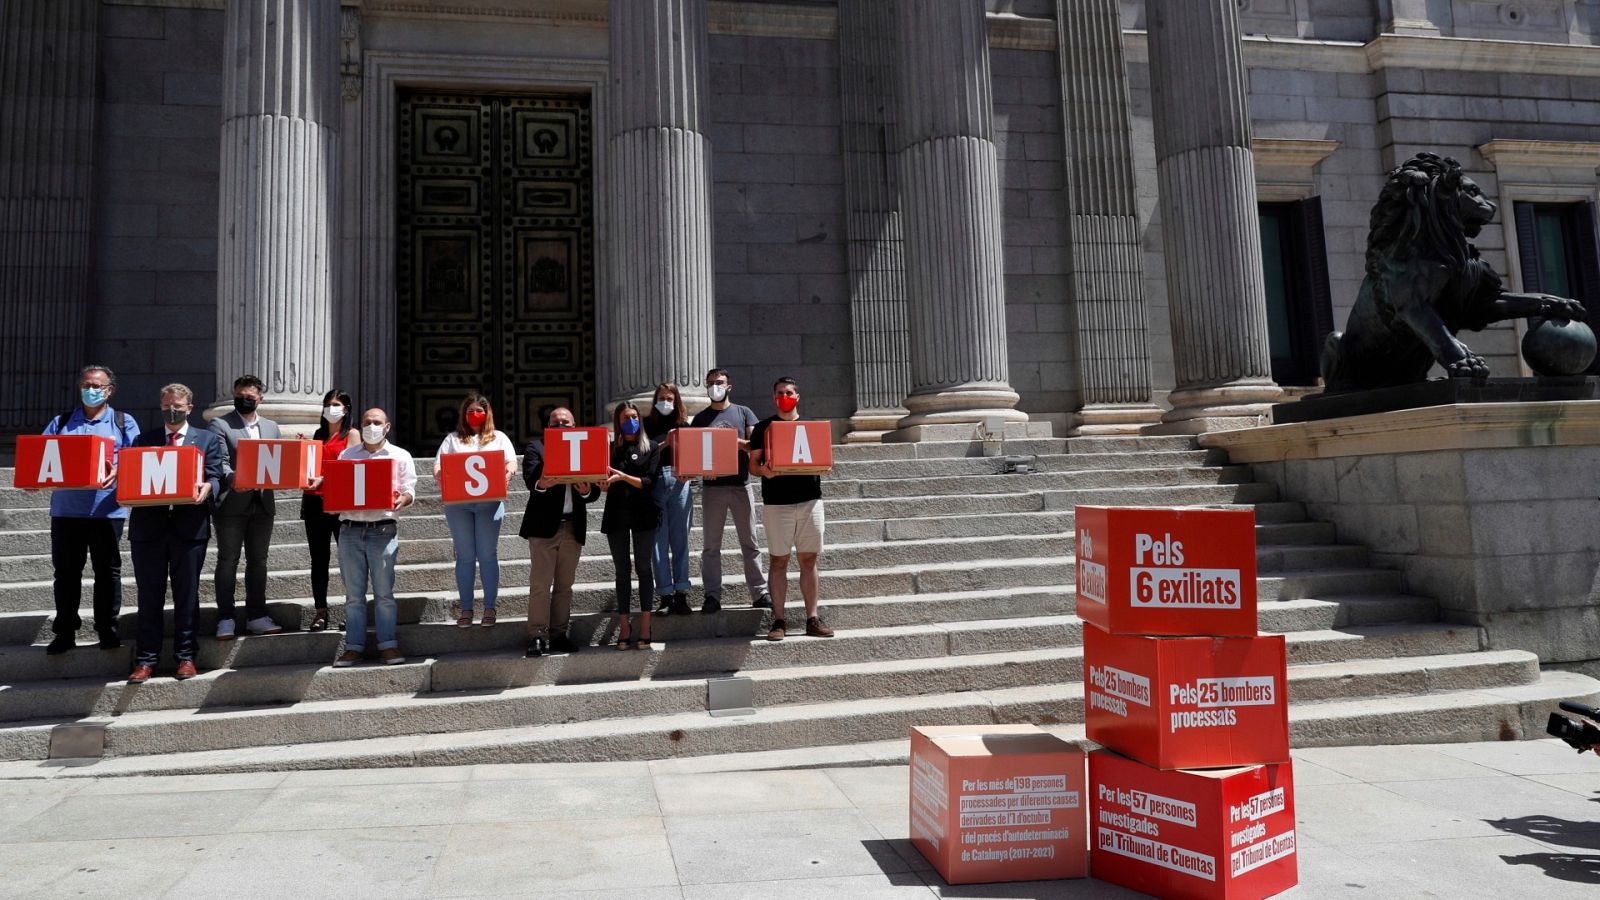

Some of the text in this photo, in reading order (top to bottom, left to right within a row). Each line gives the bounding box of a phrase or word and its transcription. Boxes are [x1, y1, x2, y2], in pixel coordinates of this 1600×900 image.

[38, 439, 64, 483] A
[562, 431, 588, 472] T
[702, 431, 713, 470] I
[792, 425, 813, 464] A
[141, 451, 177, 495] M
[256, 444, 281, 484] N
[464, 455, 490, 497] S
[353, 463, 366, 506] I
[1135, 533, 1184, 566] Pels
[1136, 571, 1237, 605] 6 exiliats
[1089, 665, 1149, 702] Pels 25 bombers
[1170, 680, 1272, 705] Pels 25 bombers
[1090, 690, 1127, 718] processats
[1171, 709, 1237, 733] processats
[962, 779, 976, 792] Per
[977, 779, 988, 791] les
[1004, 778, 1014, 790] de
[1014, 777, 1030, 790] 198
[1032, 778, 1064, 791] persones
[961, 795, 1078, 811] processades per diferents causes
[961, 814, 996, 827] derivades
[997, 813, 1006, 825] de
[1016, 812, 1049, 824] d'octubre
[1099, 784, 1195, 822] Per les 57 persones
[1230, 792, 1284, 823] Per les 57 persones
[965, 830, 976, 844] del
[1099, 806, 1159, 837] investigades
[1231, 820, 1266, 848] investigades
[961, 846, 1055, 863] de Catalunya (2017-2021)
[1100, 829, 1213, 876] pel Tribunal de Cuentas
[1231, 835, 1294, 873] pel Tribunal de Cuentas
